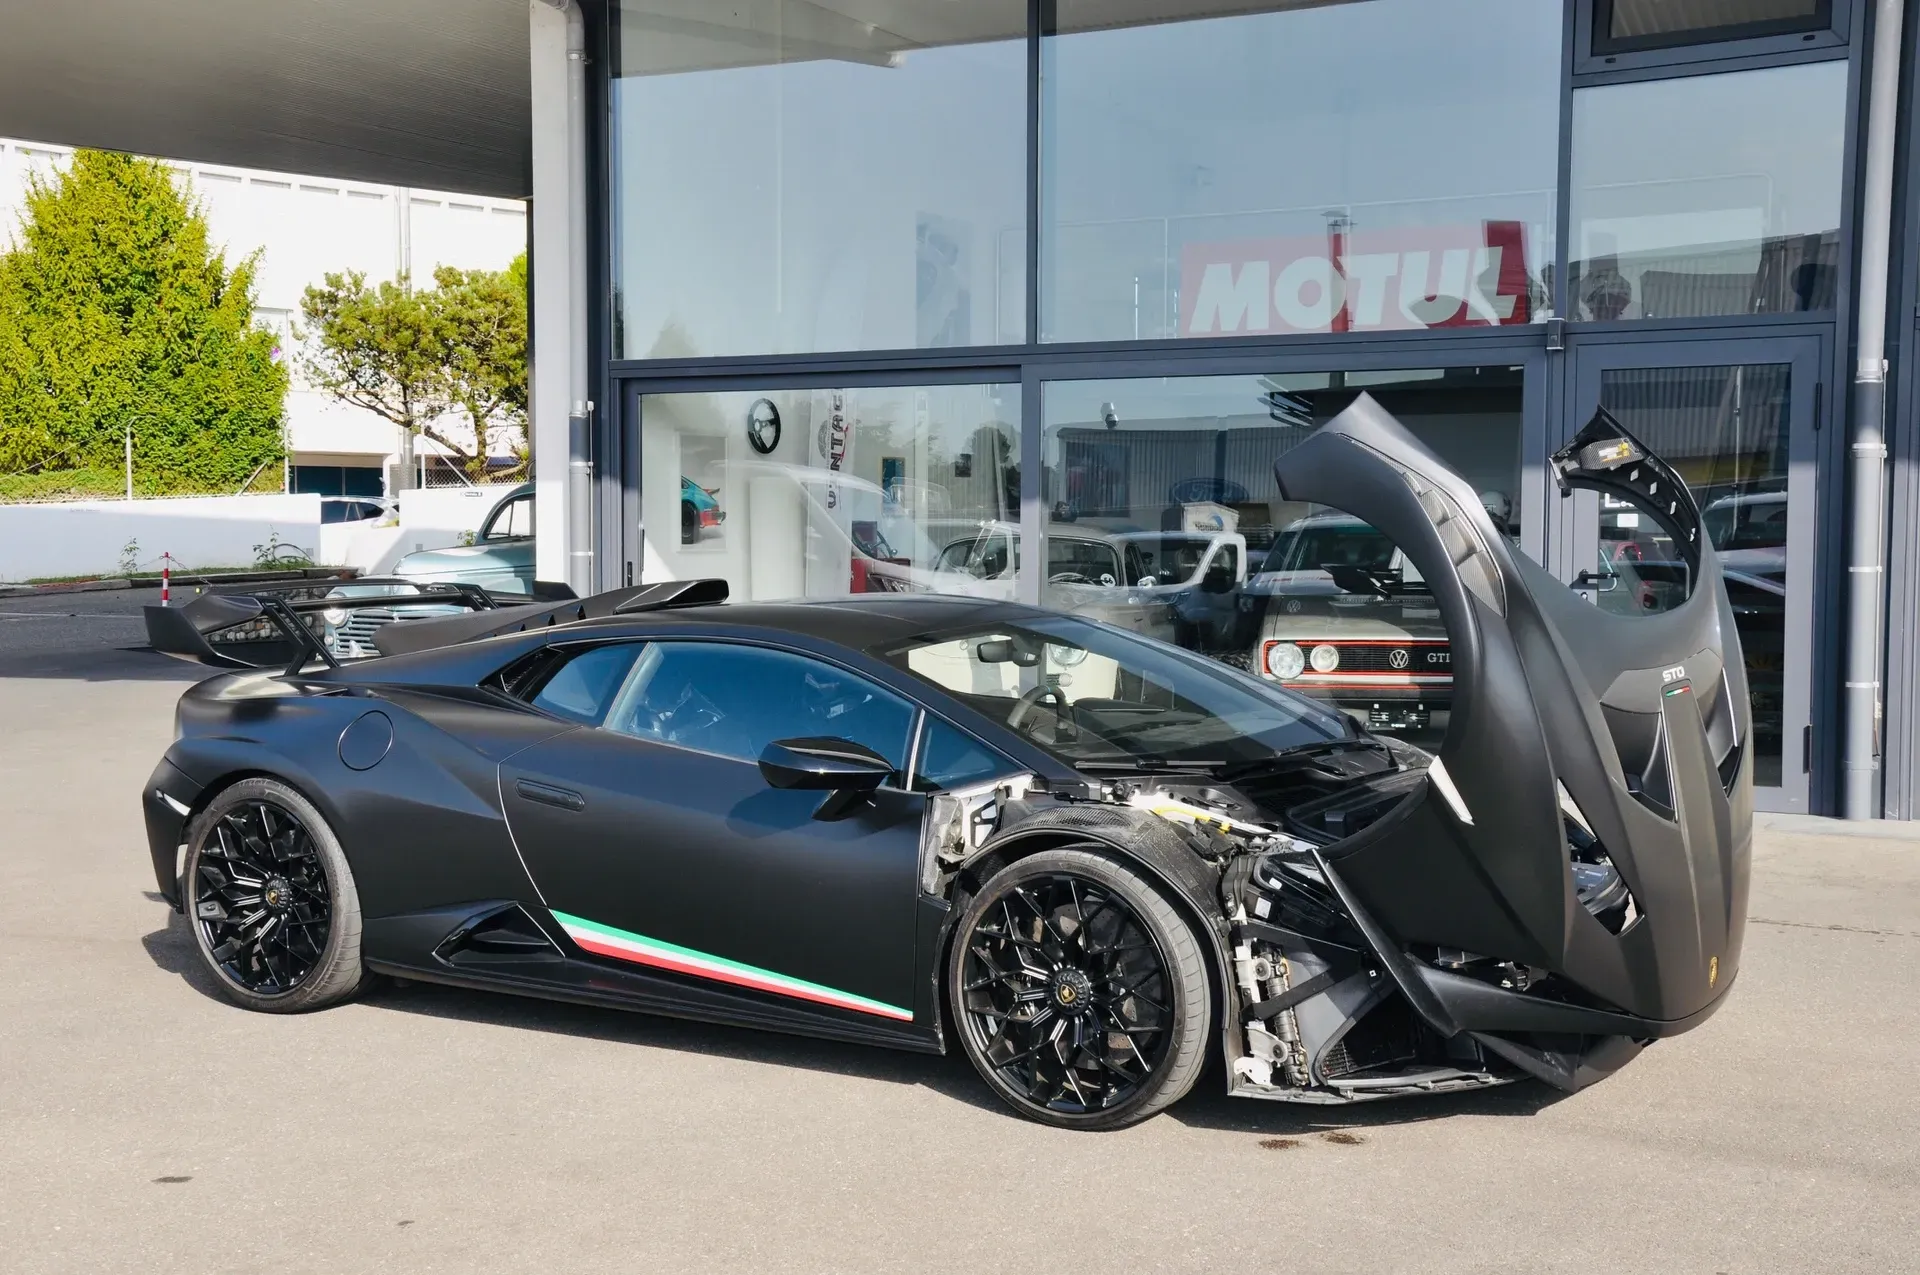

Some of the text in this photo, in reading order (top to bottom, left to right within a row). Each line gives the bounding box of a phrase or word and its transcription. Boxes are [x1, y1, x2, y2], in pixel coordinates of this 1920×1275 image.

[1189, 246, 1518, 333] MOTUL
[1427, 652, 1451, 663] GTI
[1662, 665, 1686, 682] STO
